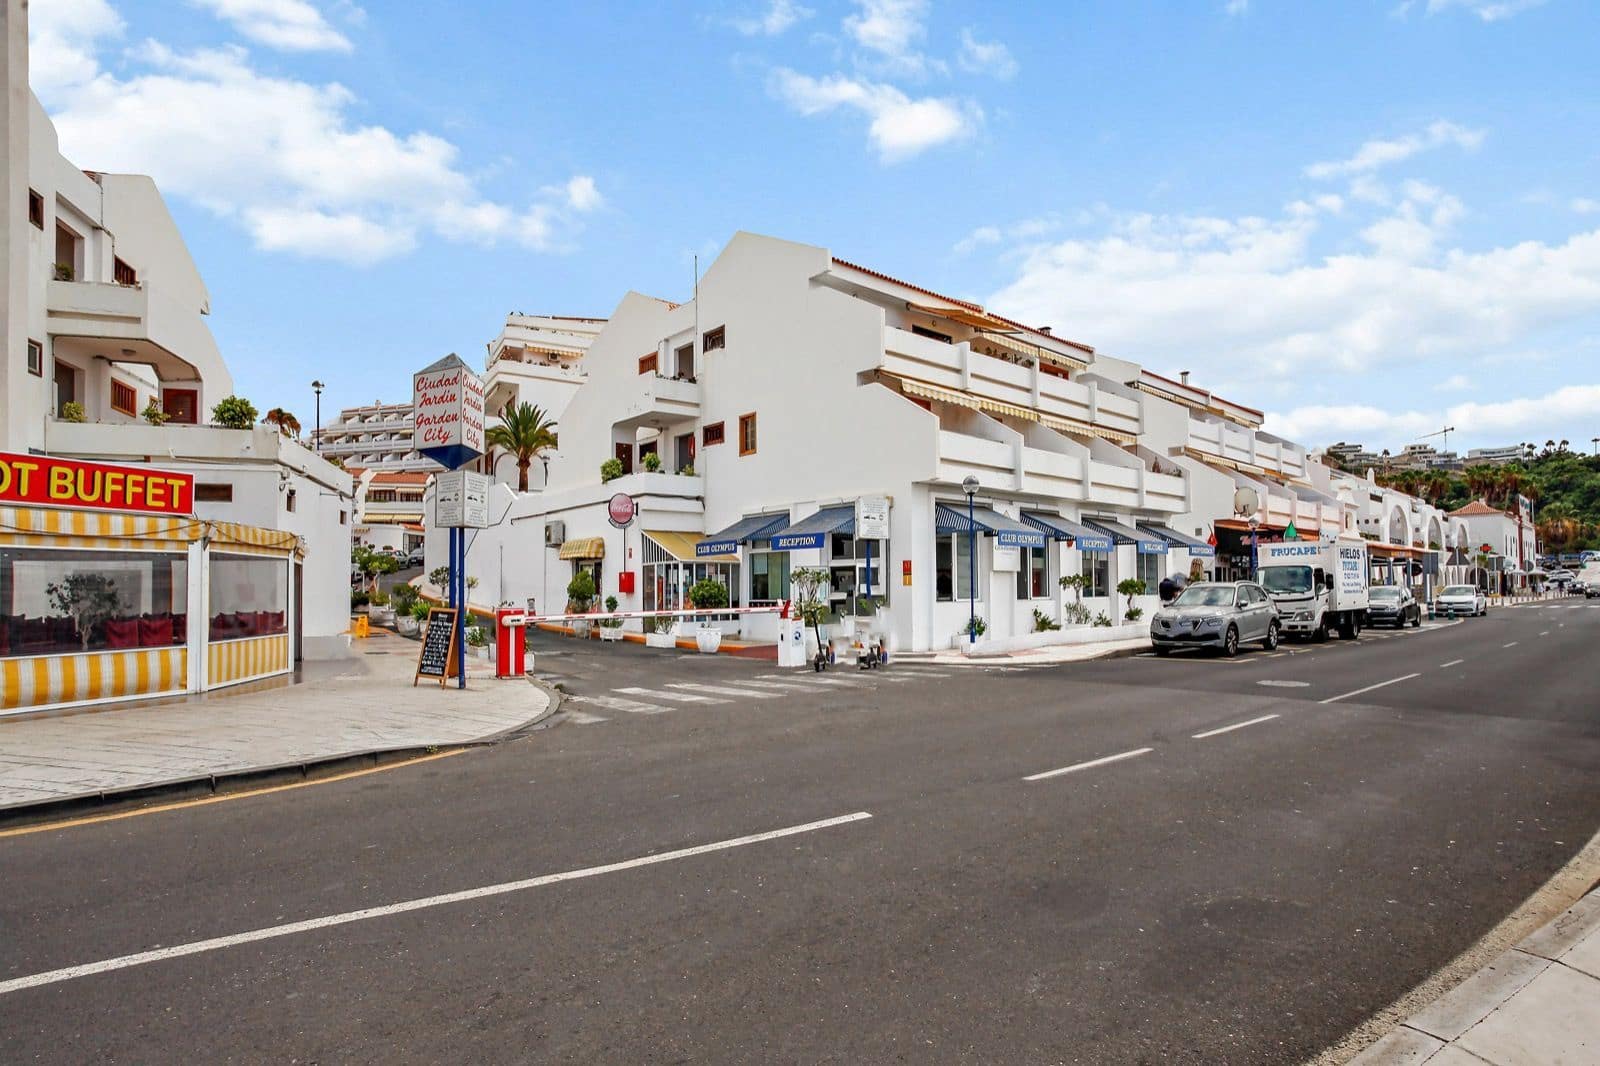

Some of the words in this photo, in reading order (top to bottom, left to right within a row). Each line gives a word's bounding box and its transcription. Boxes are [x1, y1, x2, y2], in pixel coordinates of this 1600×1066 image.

[416, 372, 459, 392] Ciudad
[463, 374, 483, 397] Ciudad
[416, 410, 460, 430] Garden
[463, 408, 483, 432] Garden
[424, 427, 453, 445] City
[466, 428, 481, 449] City
[50, 466, 186, 509] BUFFET
[697, 545, 710, 554] CLUB
[711, 543, 735, 553] OLYMPUS
[779, 536, 816, 547] RECEPTION
[1001, 534, 1017, 543] CLUB
[1018, 535, 1043, 545] OLYMPUS
[1340, 547, 1361, 560] HIELOS
